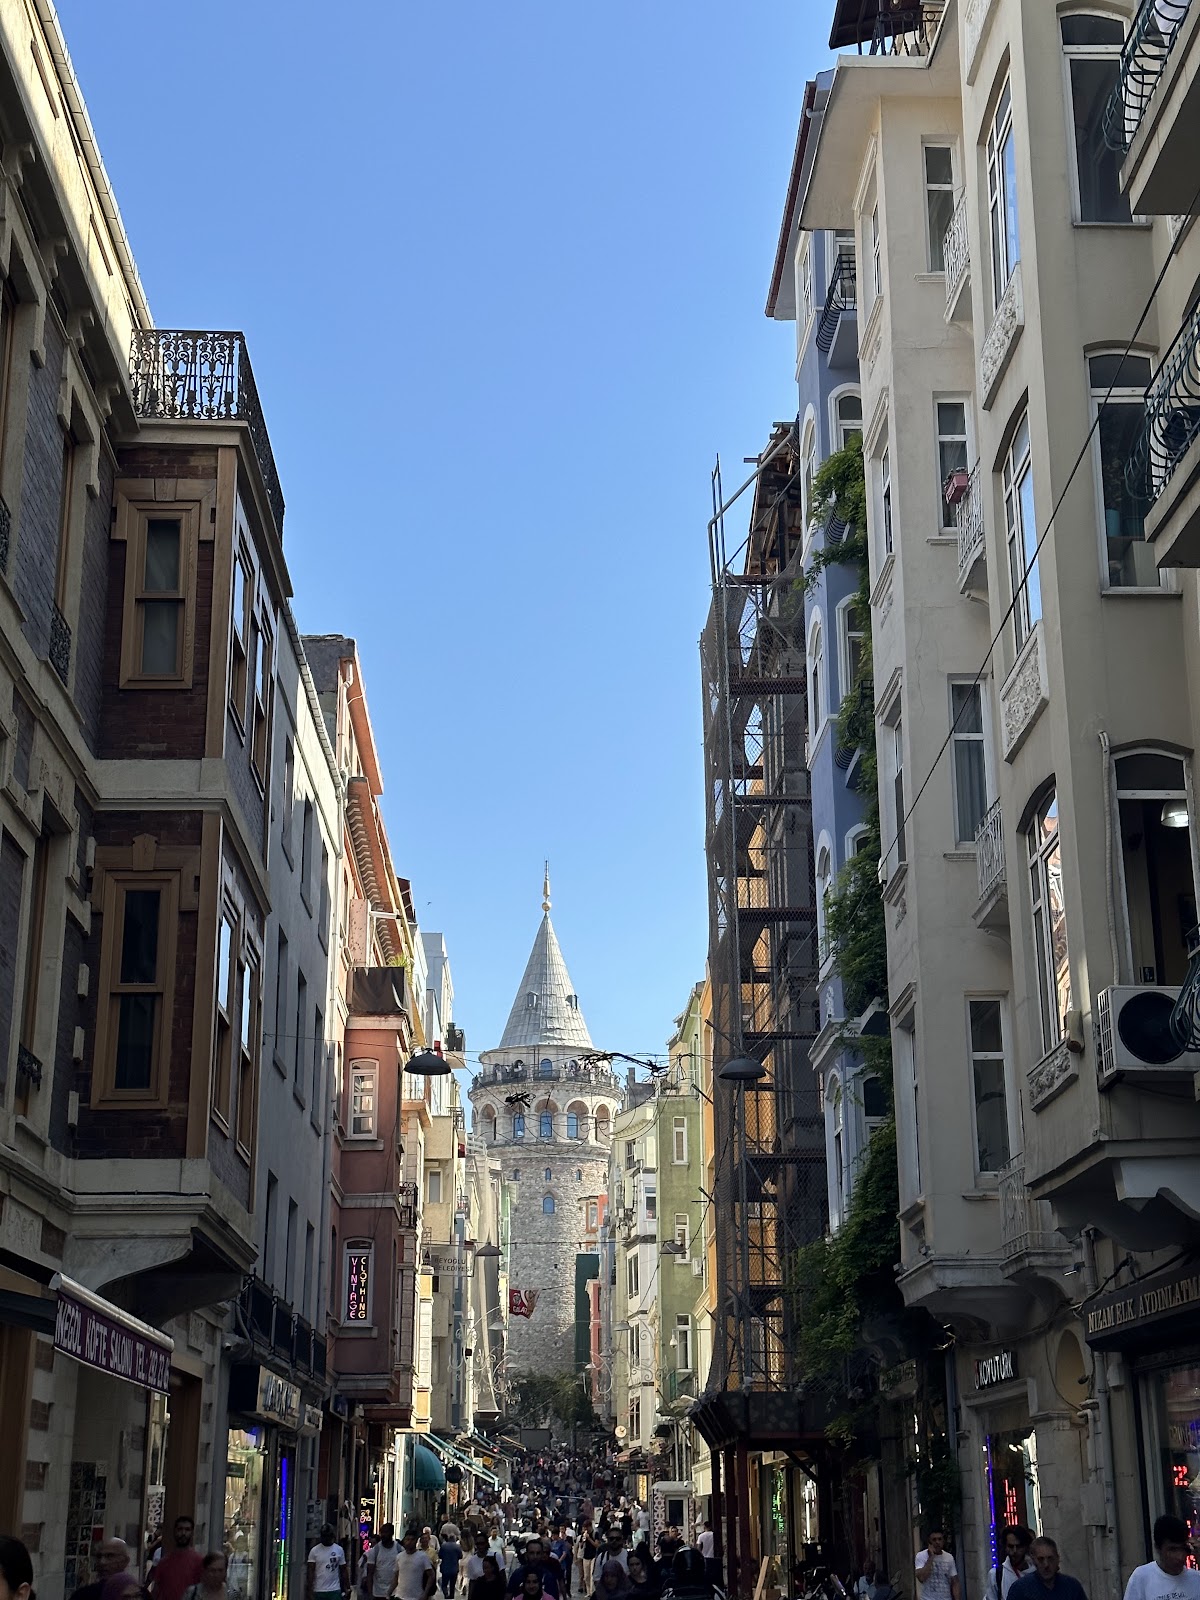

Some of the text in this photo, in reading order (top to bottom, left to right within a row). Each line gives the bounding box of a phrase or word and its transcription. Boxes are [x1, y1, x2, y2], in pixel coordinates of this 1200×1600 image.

[349, 1257, 358, 1319] VINTAGE
[358, 1256, 368, 1319] CLOTHING
[1088, 1304, 1115, 1334] NİZAM
[1138, 1277, 1200, 1318] AYDINLATM
[84, 1315, 108, 1366] KÖFTE
[109, 1329, 134, 1376] SALONU
